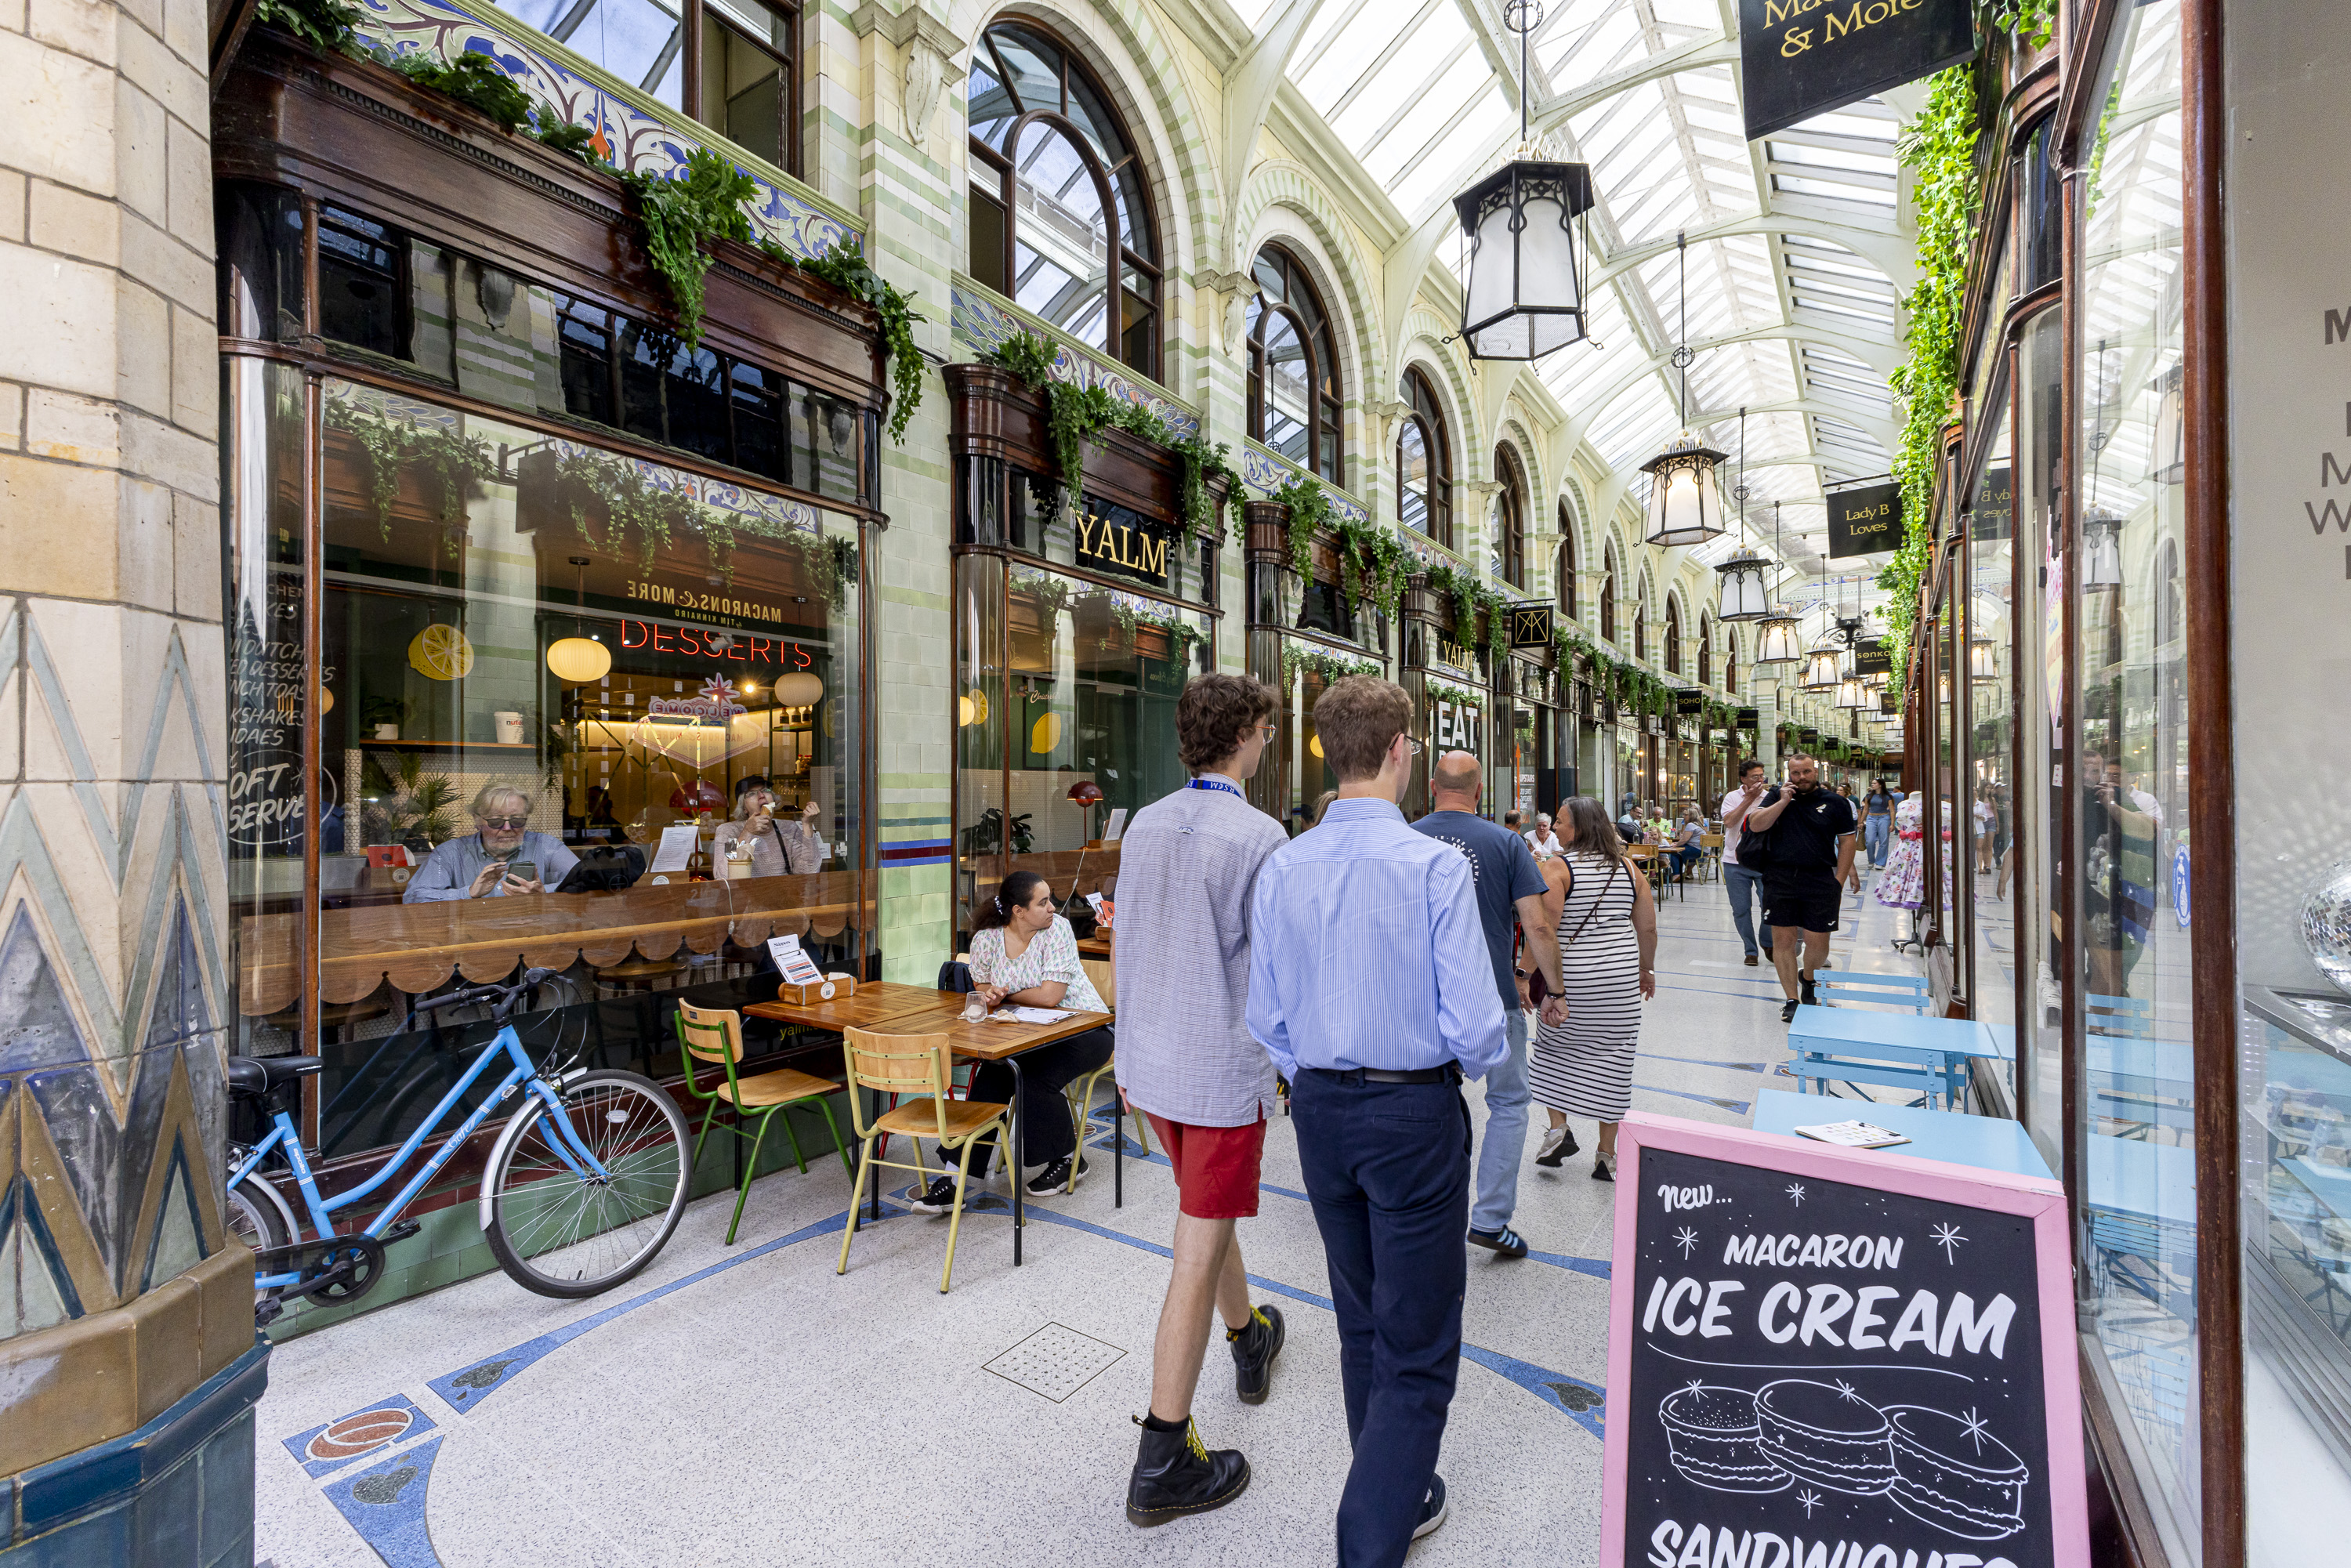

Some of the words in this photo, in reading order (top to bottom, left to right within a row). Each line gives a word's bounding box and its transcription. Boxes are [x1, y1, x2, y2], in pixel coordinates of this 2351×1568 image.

[1780, 26, 1815, 58] &
[1846, 506, 1877, 521] Lady
[1879, 504, 1890, 516] B
[1072, 508, 1168, 578] YALM
[1849, 523, 1888, 536] Loves
[621, 618, 812, 668] DESSERTS
[1443, 639, 1473, 672] YALM
[248, 660, 336, 683] DESSERS
[266, 683, 305, 701] TOAS
[1678, 697, 1701, 705] SOHO
[229, 707, 305, 727] KSHAKES
[1438, 701, 1478, 749] EAT
[230, 762, 291, 801] OFT
[1434, 835, 1466, 846] ER-VOR
[1467, 848, 1480, 886] CORNWA
[780, 1023, 819, 1041] yalm.
[293, 1148, 306, 1175] apollo
[1657, 1182, 1733, 1213] new...
[1723, 1233, 1904, 1269] MACARON
[1642, 1276, 1745, 1339] ICE
[1758, 1281, 2017, 1360] CREAM
